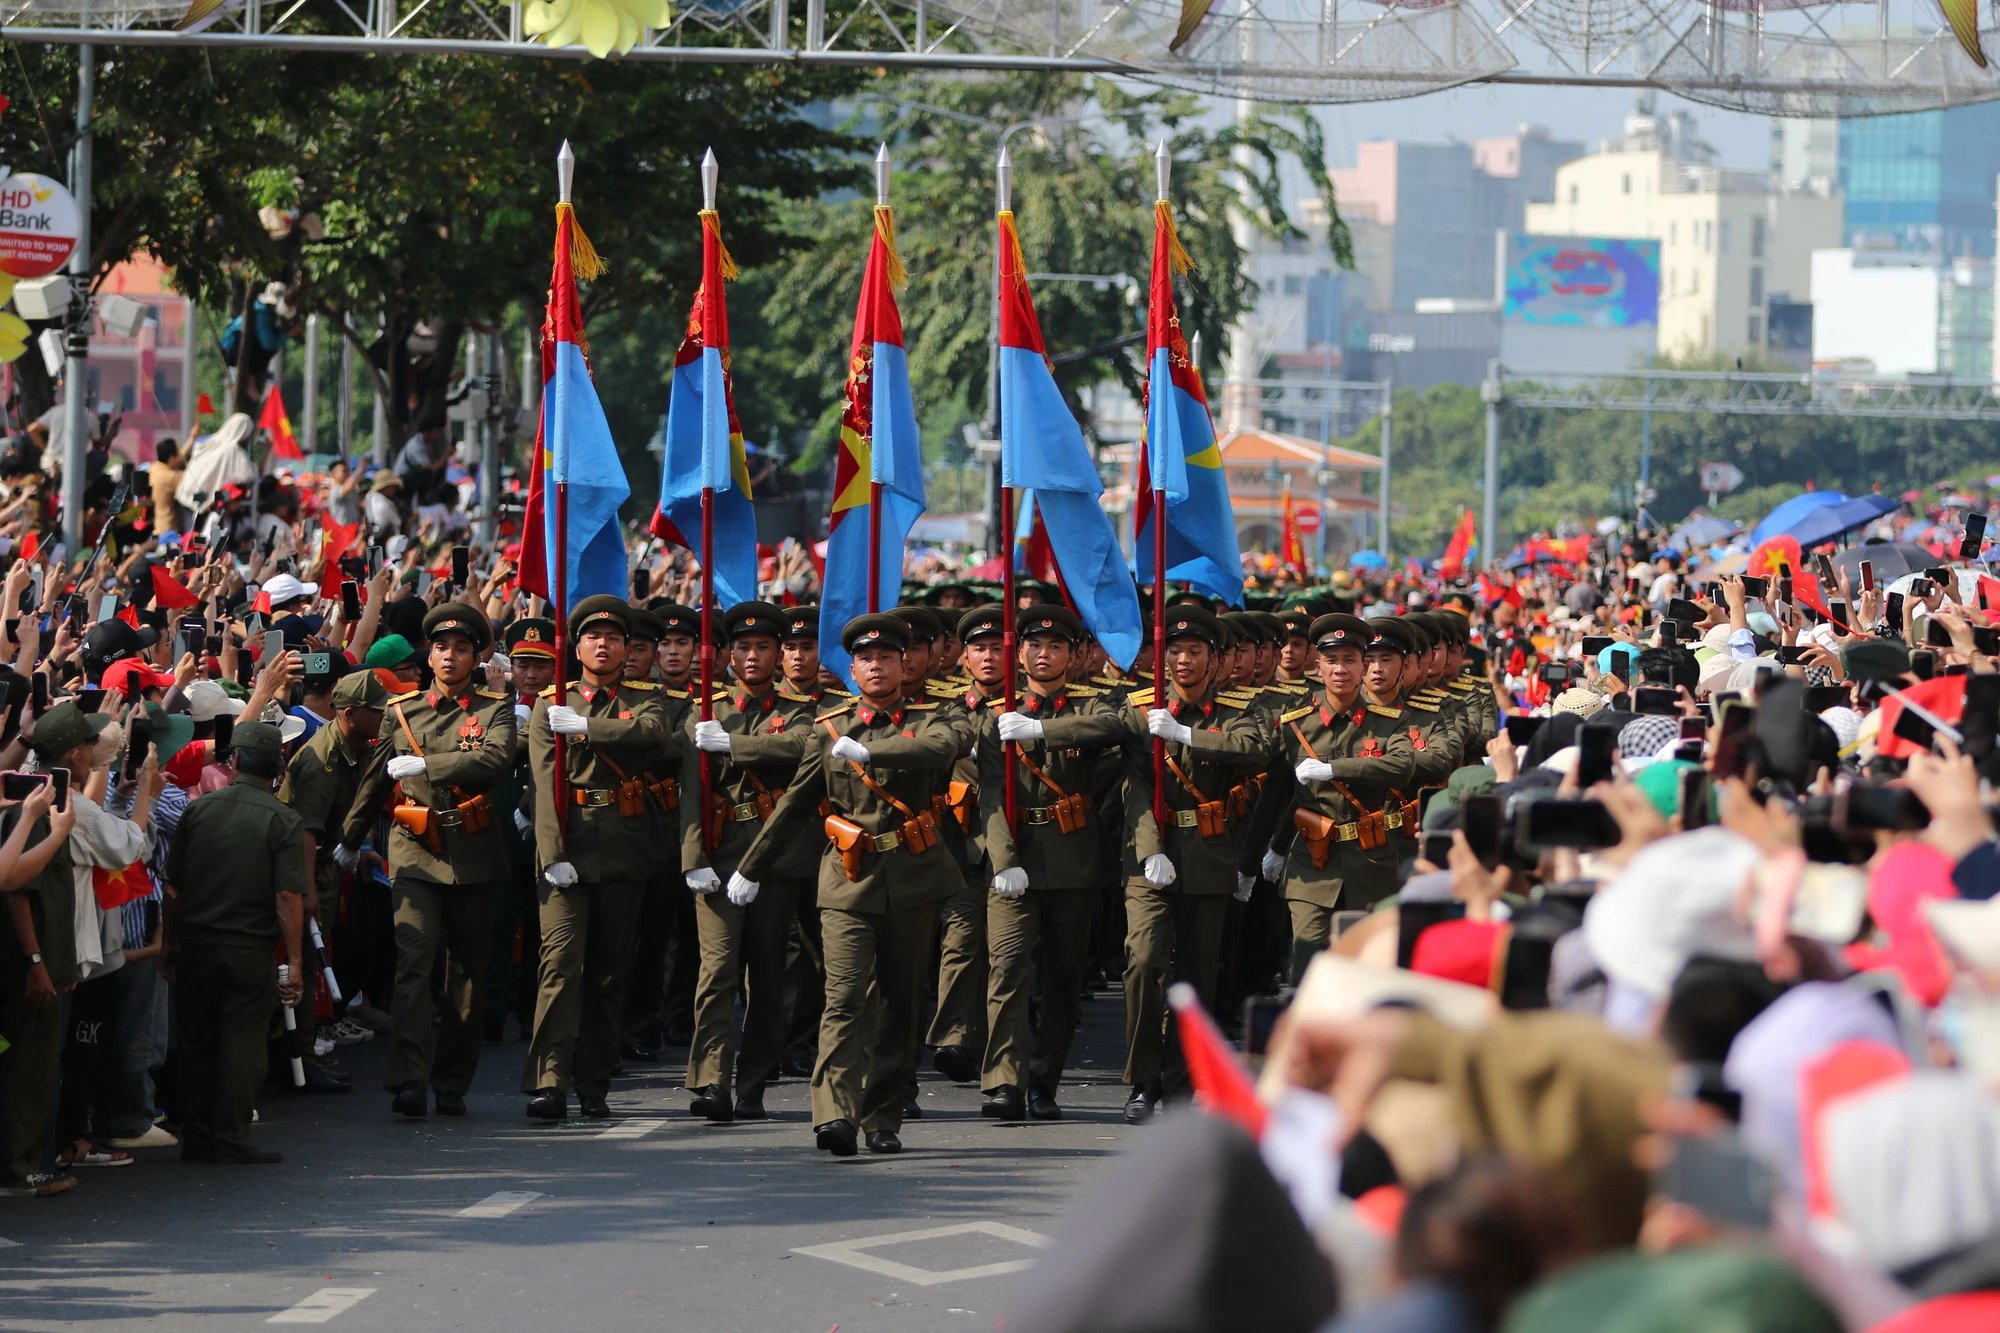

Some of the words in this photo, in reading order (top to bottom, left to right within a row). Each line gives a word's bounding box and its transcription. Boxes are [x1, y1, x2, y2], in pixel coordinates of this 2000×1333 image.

[1, 189, 32, 209] HD
[0, 209, 51, 231] Bank
[33, 240, 45, 250] TO
[46, 242, 69, 252] YOUR
[17, 251, 53, 262] RETURNS
